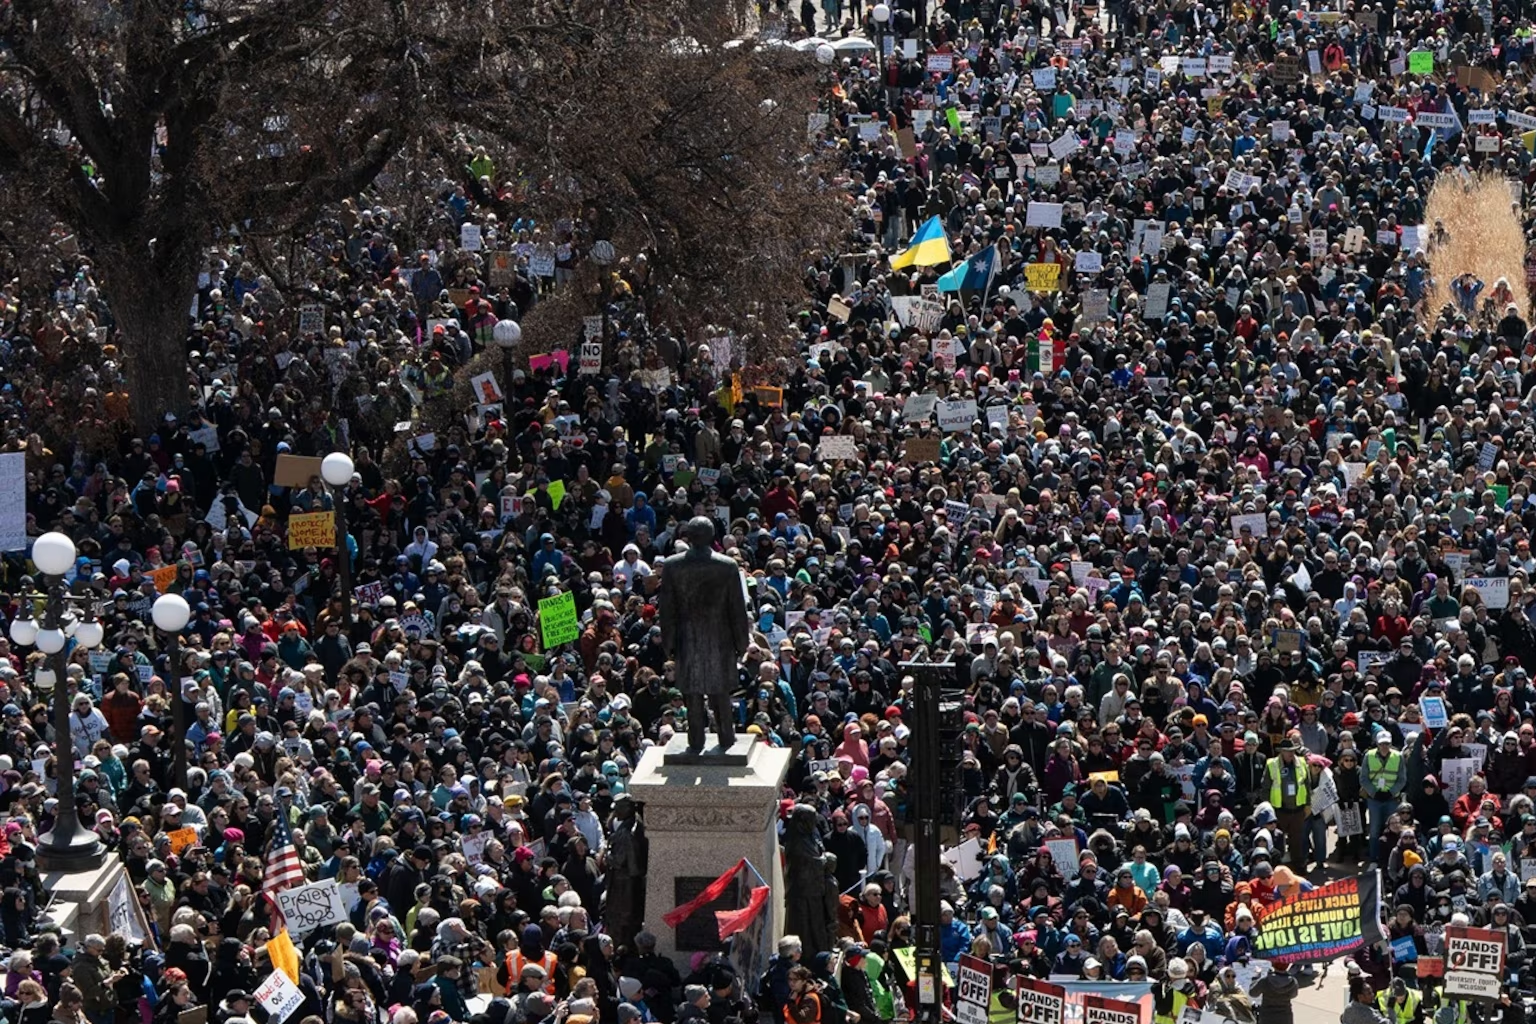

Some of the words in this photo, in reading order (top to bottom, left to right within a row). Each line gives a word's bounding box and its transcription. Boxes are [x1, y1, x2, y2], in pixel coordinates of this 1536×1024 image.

[1419, 114, 1434, 124] FIRE
[1435, 115, 1454, 126] ELON
[583, 345, 600, 356] NO
[946, 401, 967, 411] SAVE
[941, 414, 975, 425] DEMOCRACY
[291, 518, 325, 529] PROTECT
[1464, 579, 1488, 588] HANDS
[279, 884, 338, 909] Project
[1451, 940, 1498, 953] HANDS
[1450, 950, 1497, 970] OFF!
[962, 969, 988, 987] HANDS
[959, 979, 988, 1003] OFF!
[1021, 988, 1060, 1008] HANDS
[1089, 1009, 1134, 1024] HANDS
